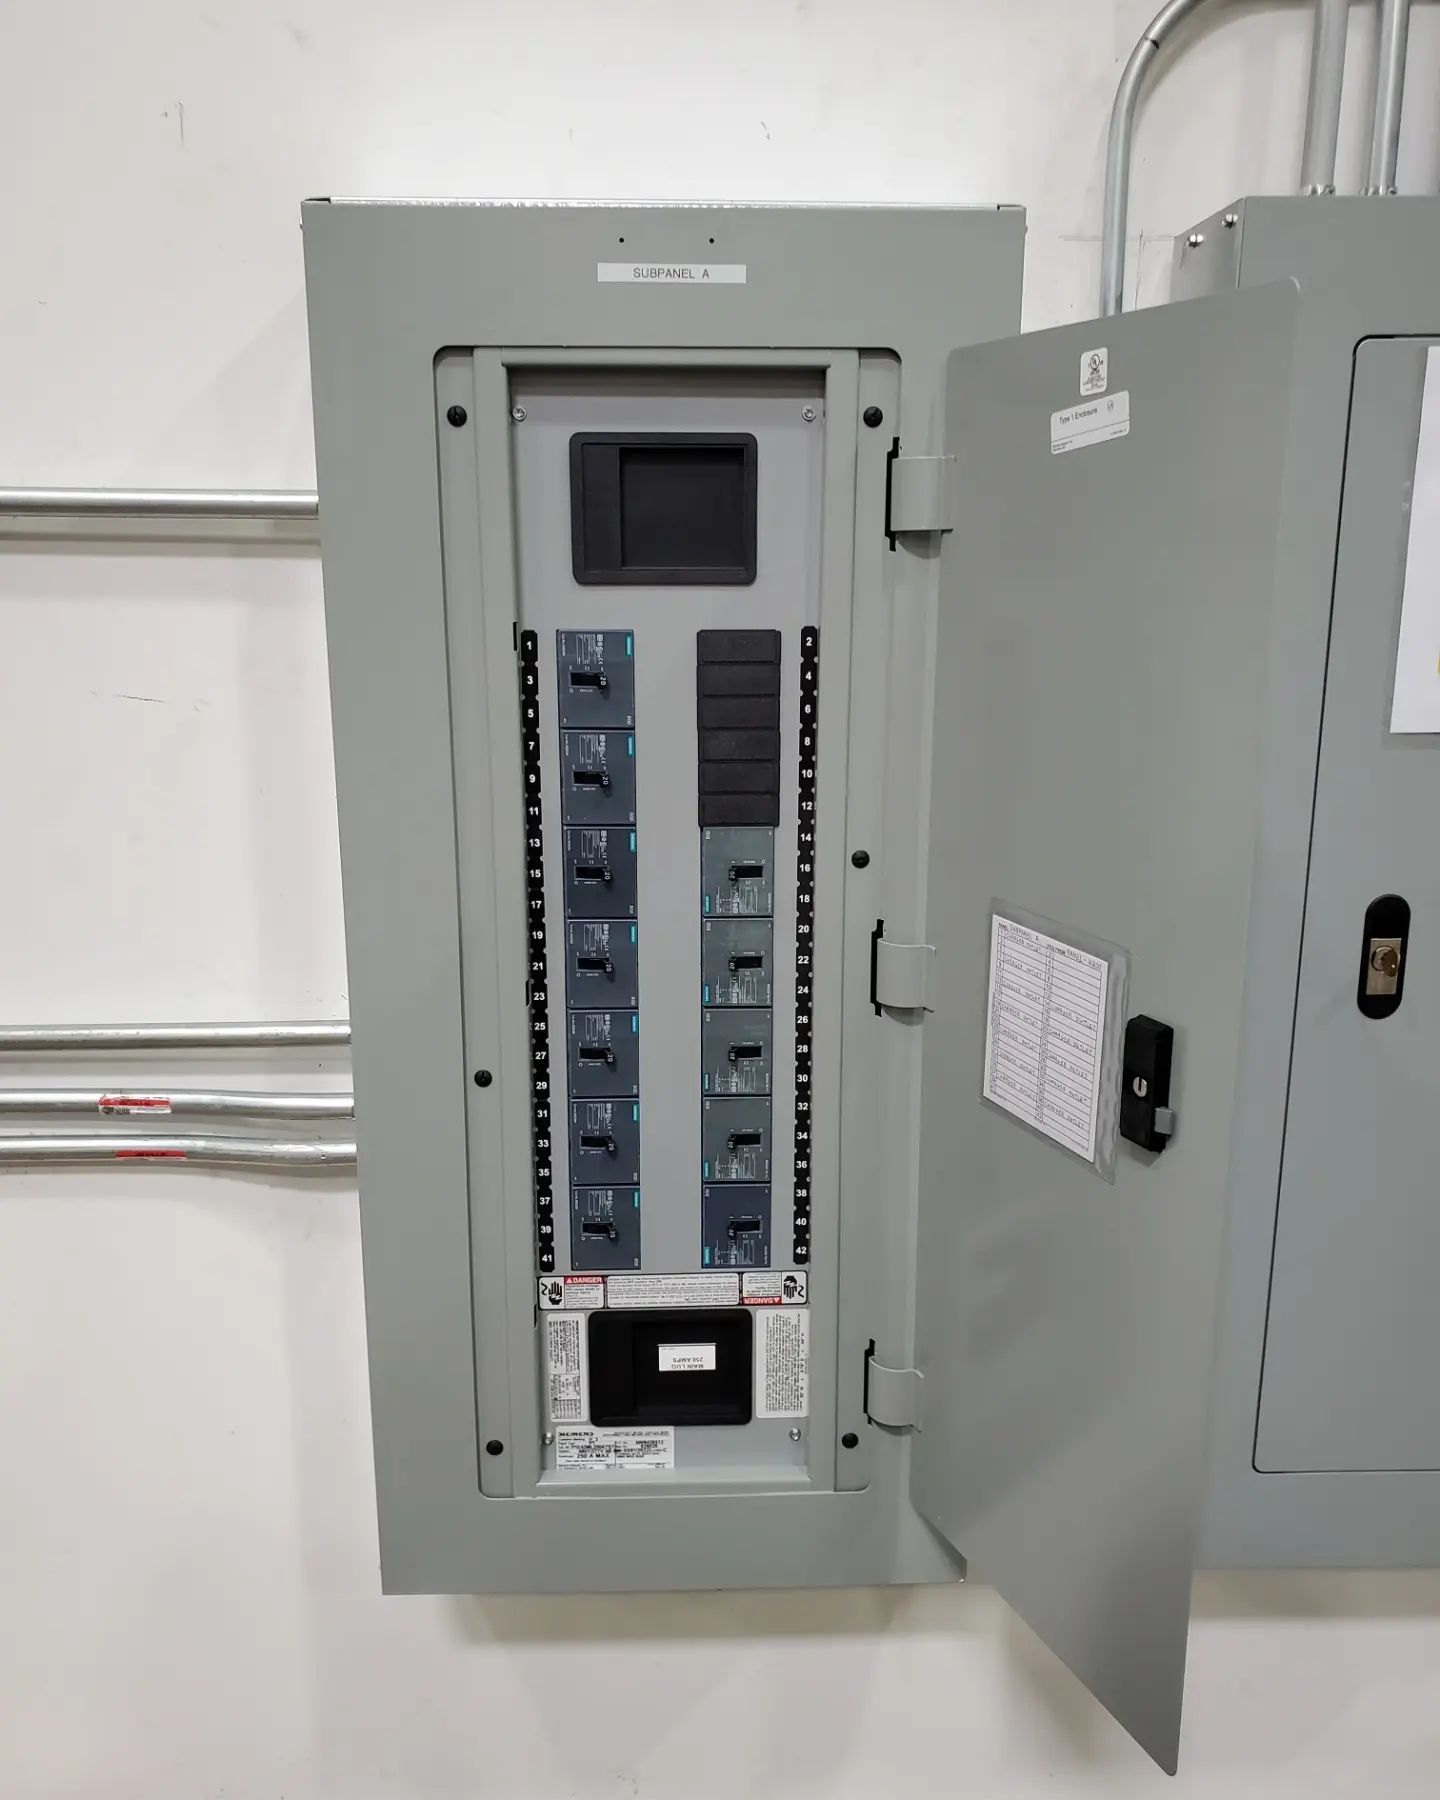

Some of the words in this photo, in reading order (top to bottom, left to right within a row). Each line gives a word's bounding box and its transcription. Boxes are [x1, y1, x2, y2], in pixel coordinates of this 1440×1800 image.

[632, 266, 695, 279] SUBPANEL
[701, 268, 710, 279] A
[1059, 416, 1070, 425] Type
[1074, 408, 1097, 420] Enclosure
[526, 641, 532, 650] 1
[806, 636, 813, 647] 2
[527, 675, 534, 685] 3
[600, 676, 606, 685] 20
[805, 671, 812, 681] 4
[527, 708, 534, 718] 5
[804, 704, 811, 714] 6
[528, 741, 535, 750] 7
[804, 736, 811, 746] 8
[801, 769, 813, 778] 10
[529, 774, 536, 783] 9
[602, 776, 608, 785] 20
[801, 801, 813, 811] 12
[529, 806, 539, 816] 11
[800, 833, 812, 842] 14
[529, 838, 541, 848] 13
[799, 863, 811, 872] 16
[530, 869, 541, 878] 15
[604, 872, 610, 880] 20
[798, 894, 811, 903] 18
[531, 900, 542, 909] 17
[798, 924, 810, 933] 20
[532, 930, 544, 940] 19
[797, 955, 809, 964] 22
[532, 962, 543, 971] 21
[797, 985, 809, 994] 24
[533, 992, 546, 1001] 23
[796, 1015, 809, 1024] 26
[534, 1022, 546, 1031] 25
[796, 1044, 809, 1053] 28
[535, 1051, 547, 1060] 27
[607, 1054, 613, 1062] 20
[797, 1074, 808, 1083] 30
[536, 1081, 548, 1090] 29
[797, 1102, 809, 1111] 32
[537, 1109, 548, 1118] 31
[796, 1131, 808, 1140] 34
[537, 1139, 549, 1148] 33
[608, 1143, 614, 1151] 20
[796, 1160, 808, 1169] 36
[538, 1168, 550, 1177] 35
[796, 1189, 807, 1197] 38
[539, 1196, 551, 1205] 37
[795, 1217, 807, 1226] 40
[540, 1225, 552, 1234] 39
[795, 1246, 807, 1254] 42
[541, 1254, 552, 1262] 41
